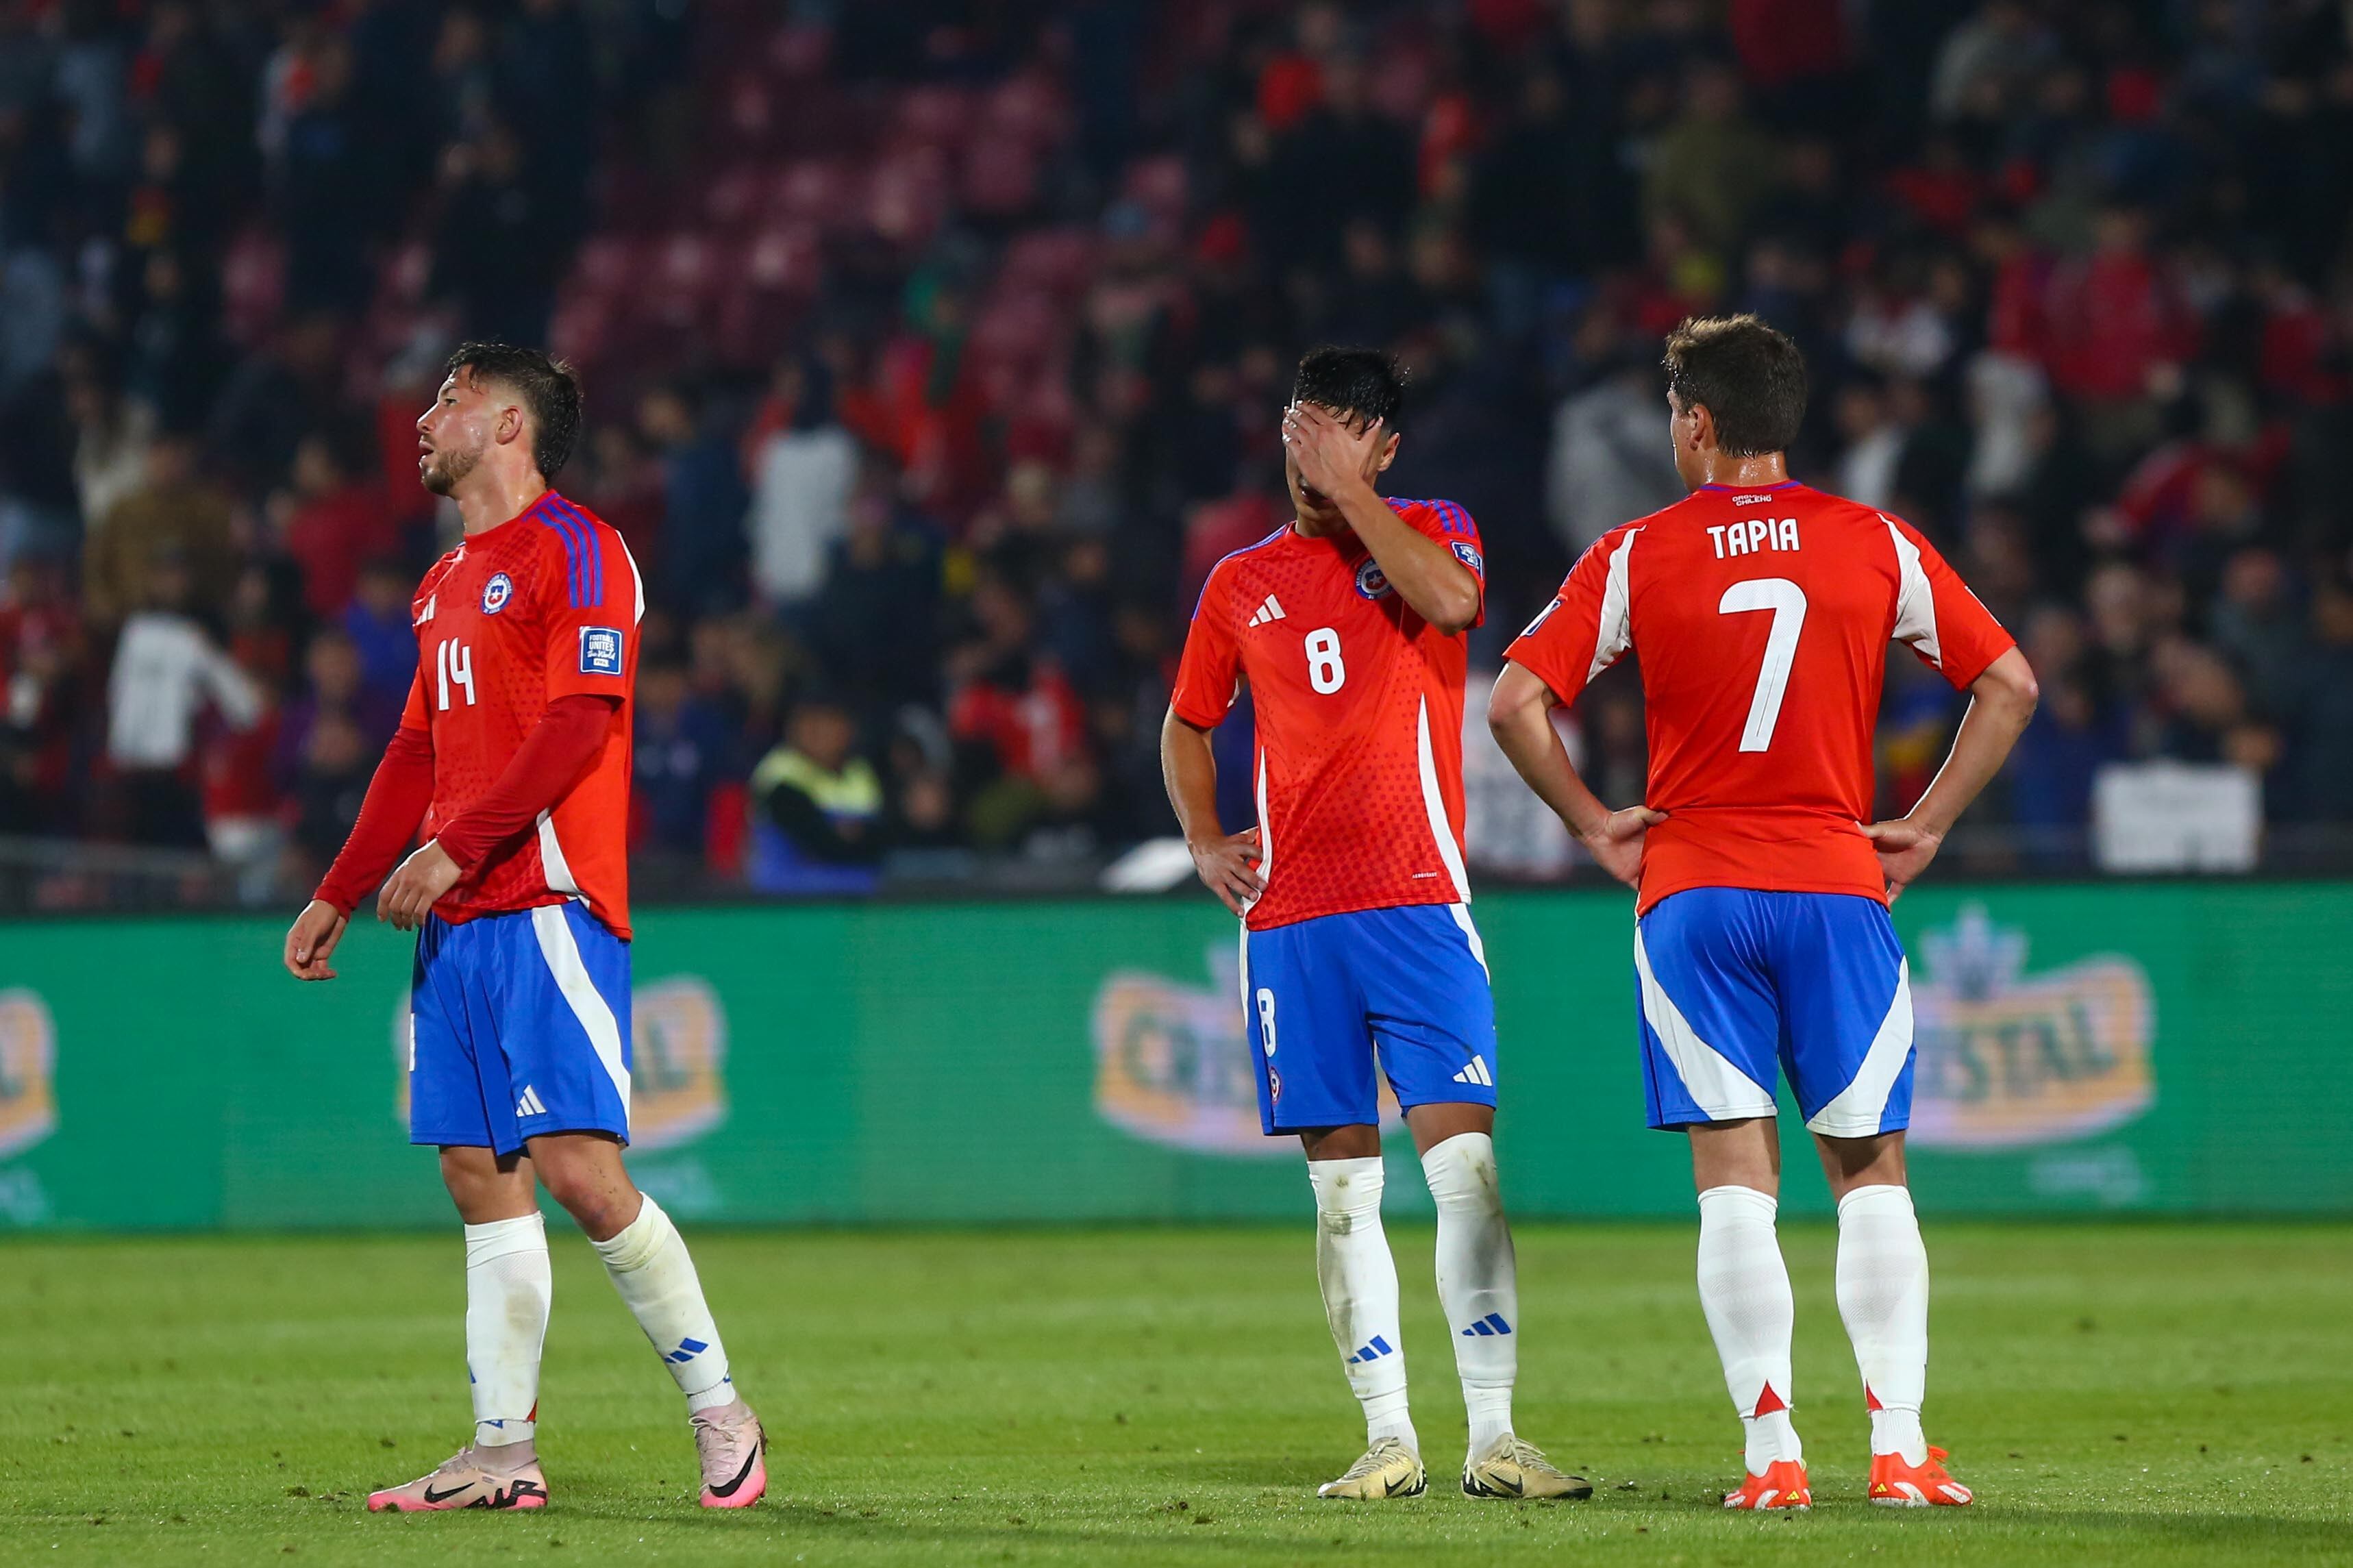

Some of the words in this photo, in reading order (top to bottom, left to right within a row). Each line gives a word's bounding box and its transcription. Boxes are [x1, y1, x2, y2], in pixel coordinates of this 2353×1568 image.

[1706, 518, 1800, 559] TAPIA
[437, 637, 475, 711] 14
[588, 641, 614, 651] UNITES
[1305, 627, 1345, 695] 8
[1719, 577, 1807, 751] 7
[1256, 988, 1276, 1057] 8
